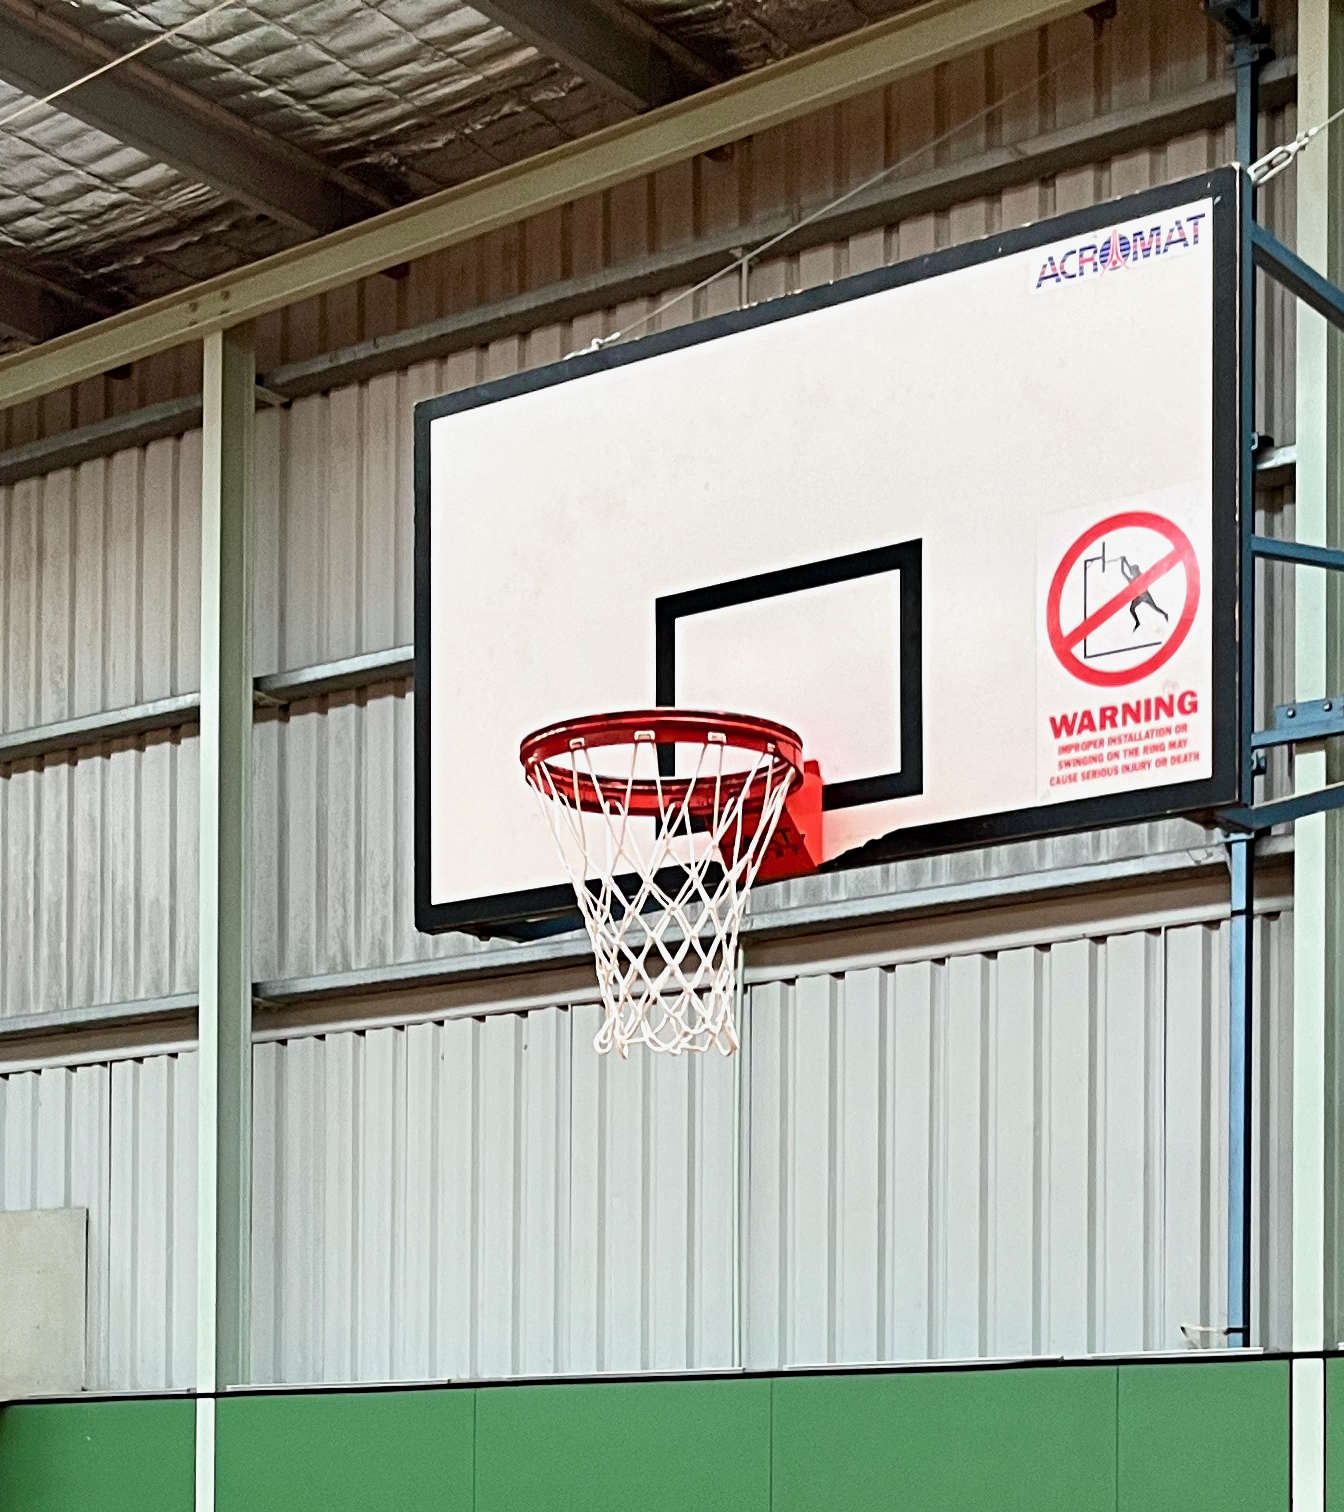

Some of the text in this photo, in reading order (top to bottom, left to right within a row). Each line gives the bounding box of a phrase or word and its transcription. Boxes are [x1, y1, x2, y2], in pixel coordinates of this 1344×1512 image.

[1036, 213, 1206, 288] ACROMAT
[1049, 690, 1198, 739] WARNING
[1058, 723, 1188, 755] IMPROPER INSTALLATION OR
[1058, 739, 1188, 771] SWINGING ON THE RING MAY
[1049, 751, 1200, 787] CAUSE SERIOUS INJURY OR DEATH
